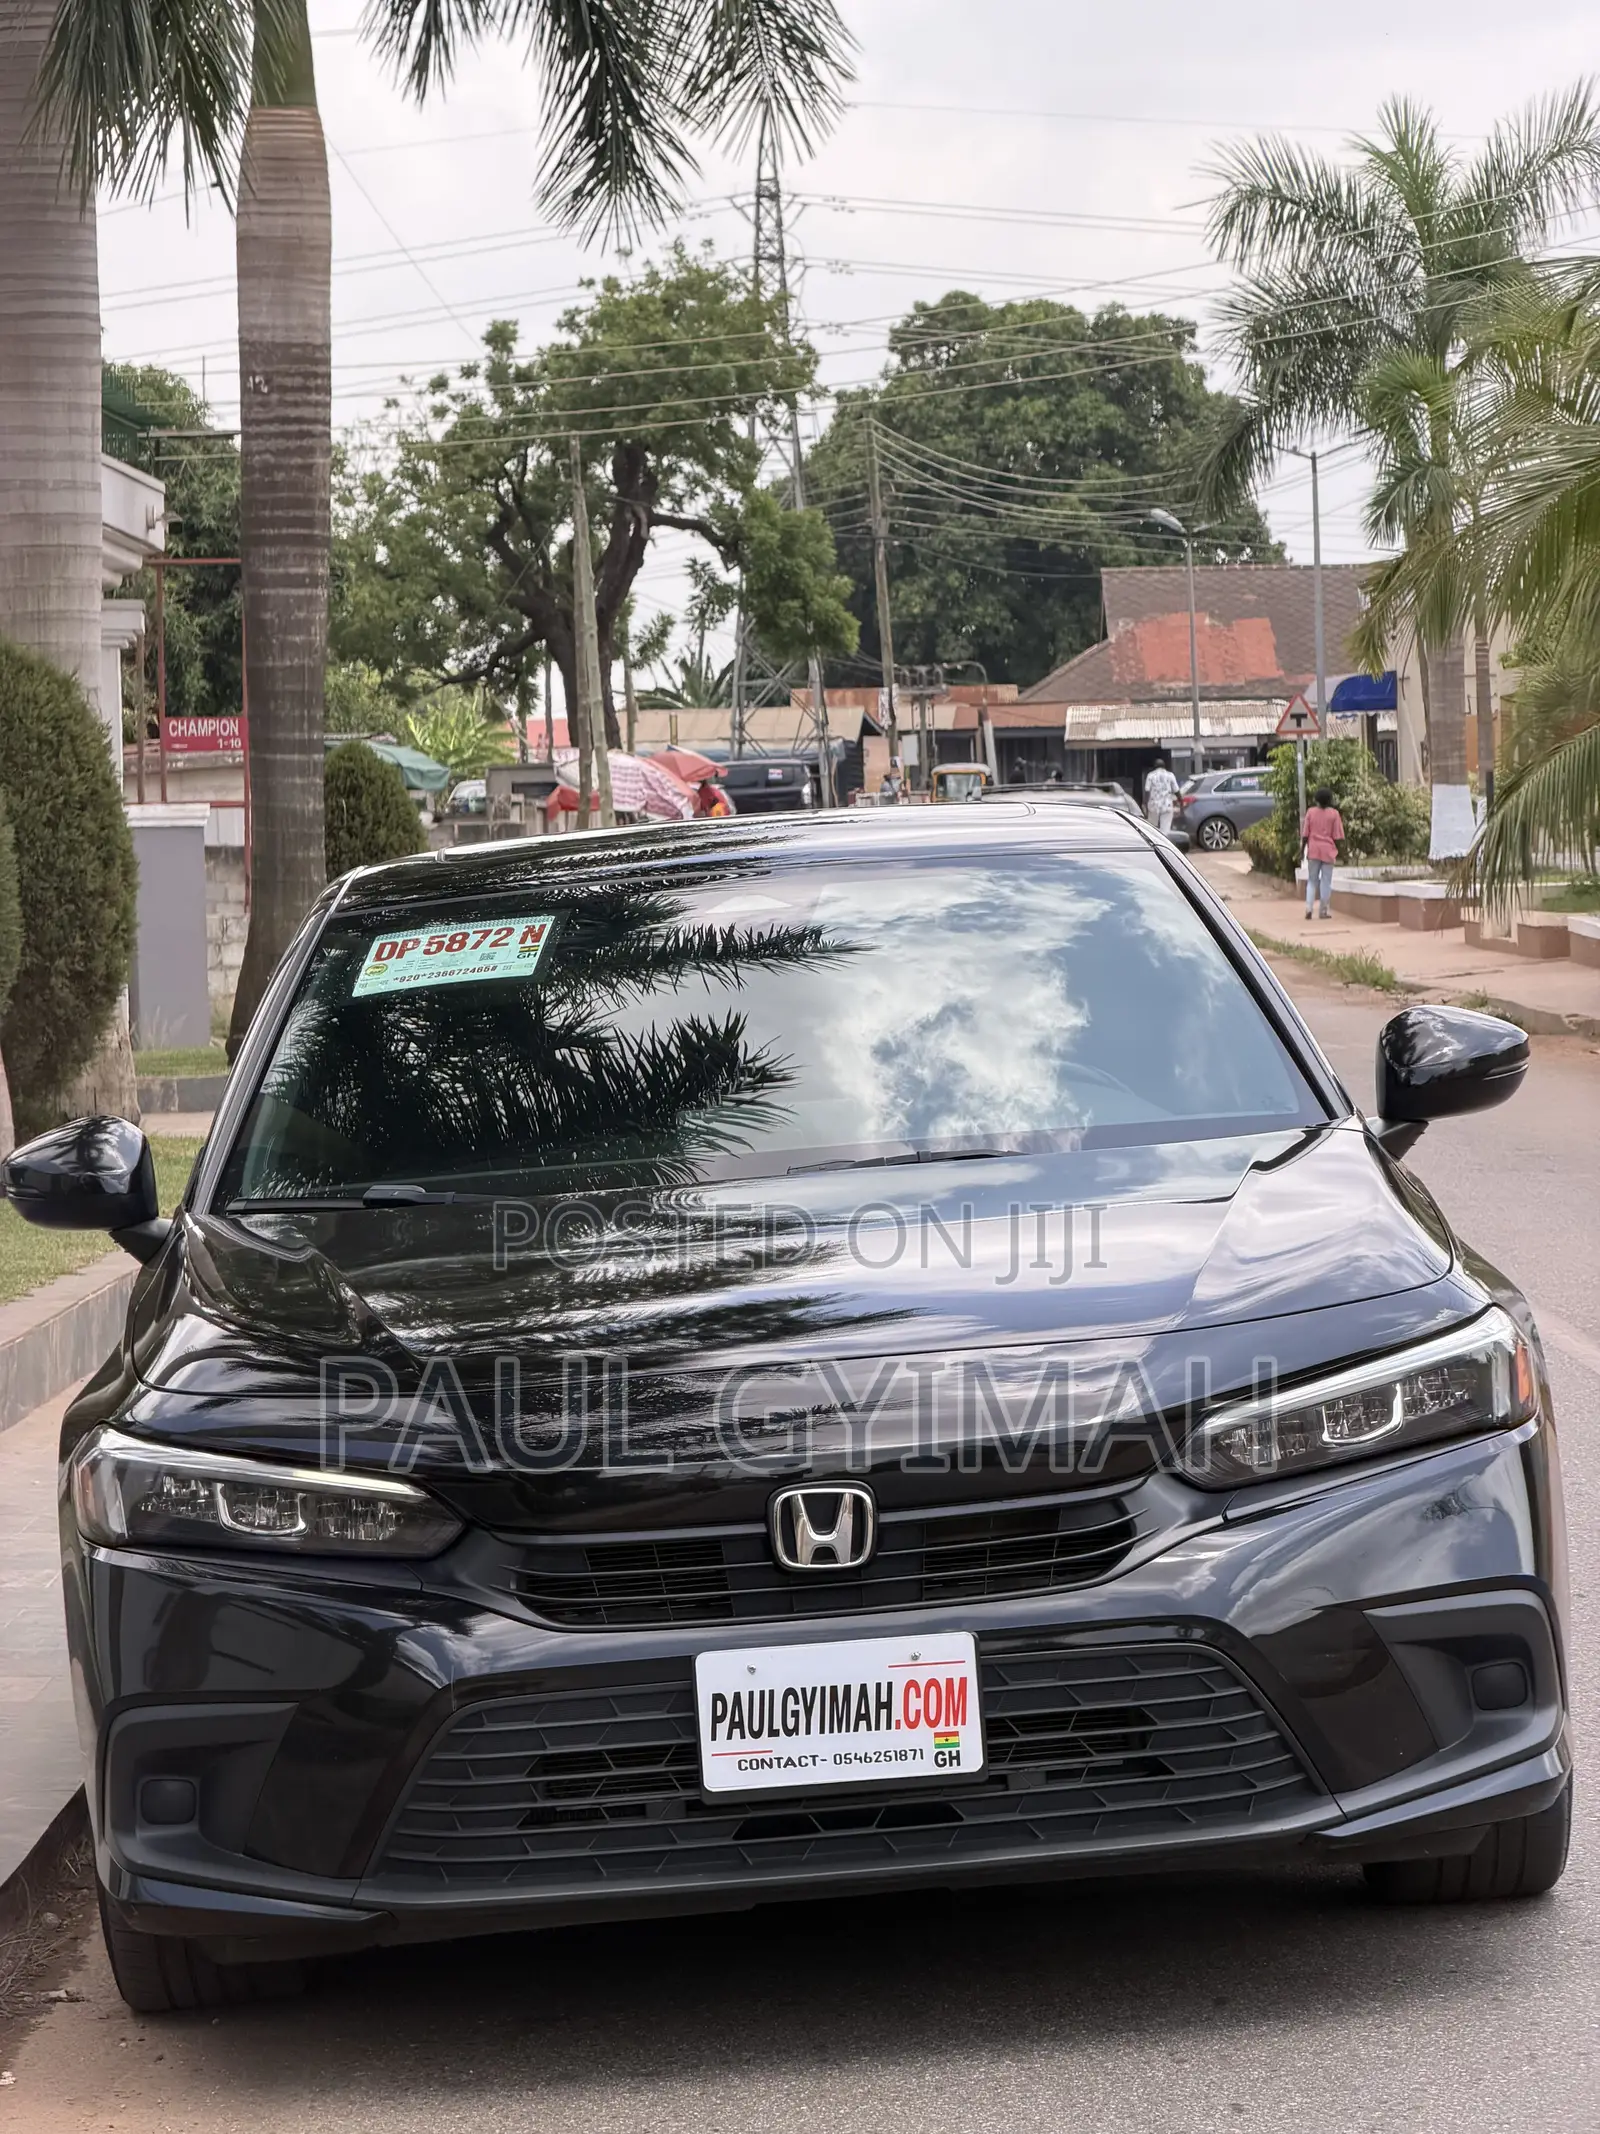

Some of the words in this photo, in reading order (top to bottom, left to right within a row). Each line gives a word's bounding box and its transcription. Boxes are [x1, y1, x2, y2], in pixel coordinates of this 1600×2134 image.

[169, 719, 239, 737] CHAMPION
[373, 938, 421, 962] DP
[423, 927, 515, 955] 5872
[519, 923, 547, 944] N
[517, 952, 537, 960] GH
[710, 1677, 967, 1742] PAULGYIMAH.COM
[737, 1754, 827, 1771] CONTACT-
[833, 1749, 924, 1766] 0546251871
[934, 1750, 961, 1768] GH
